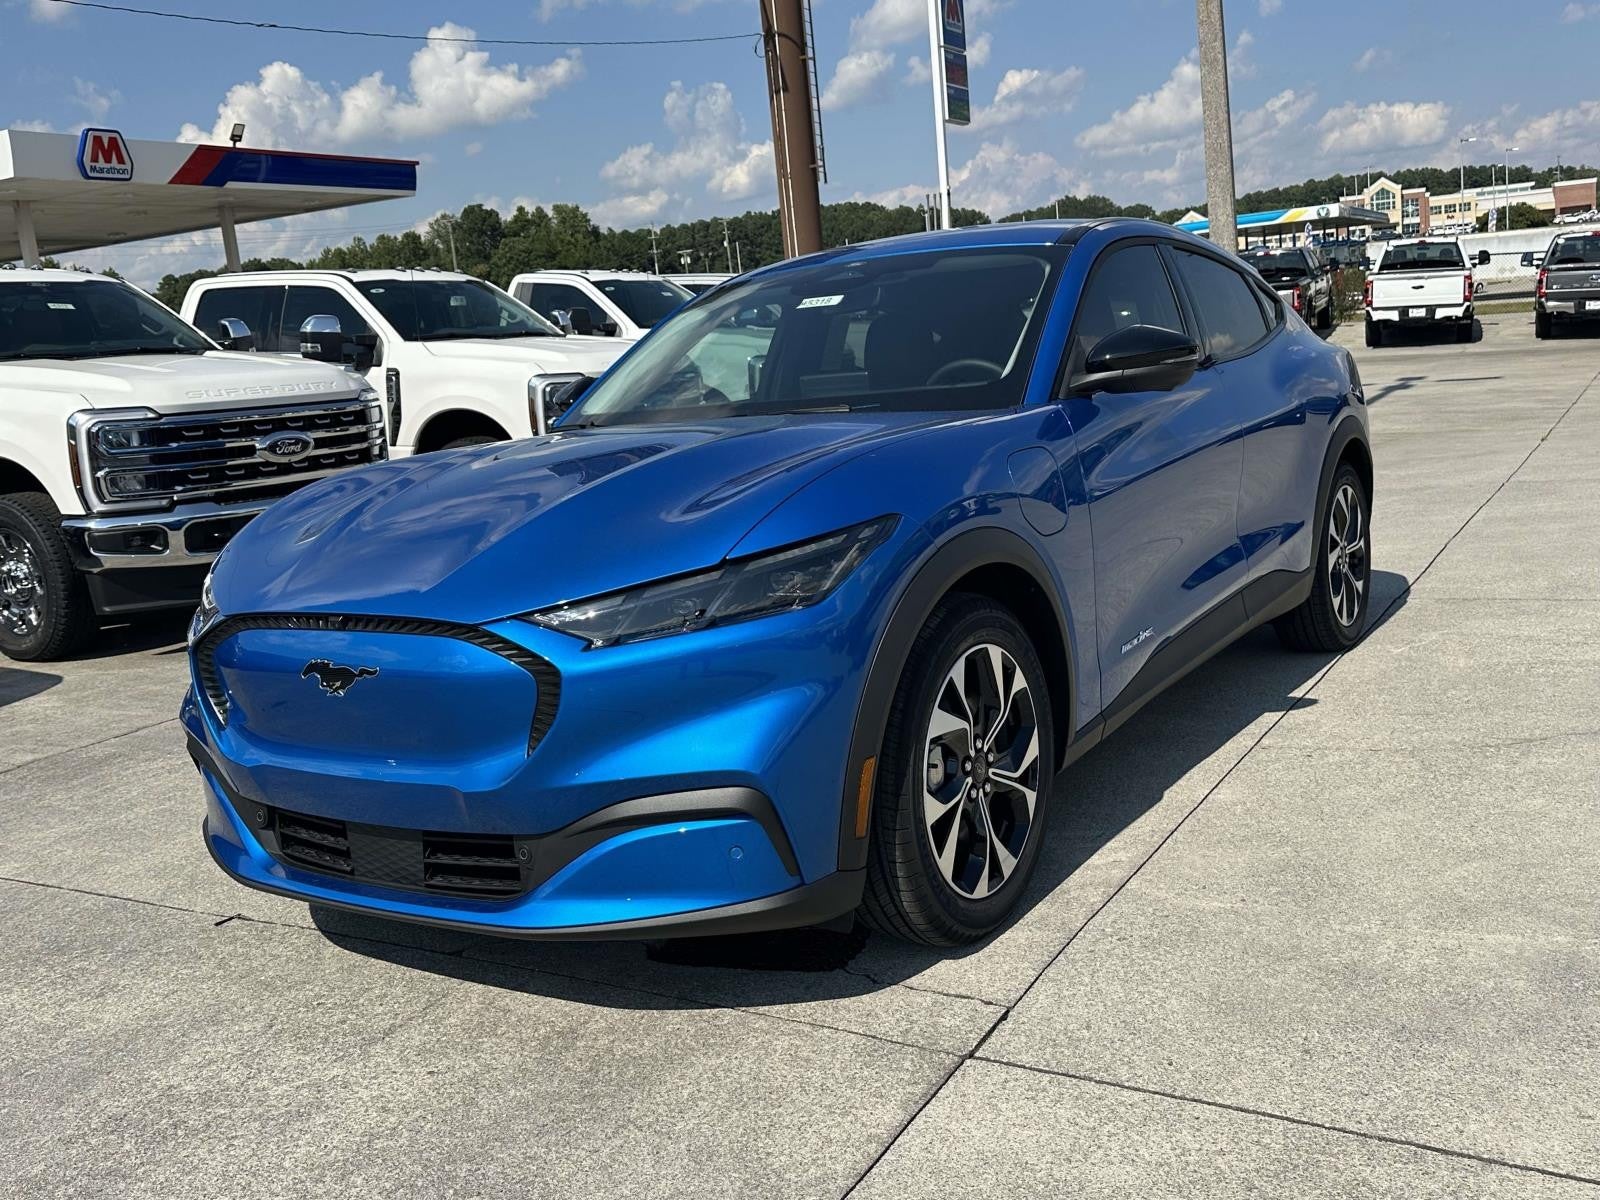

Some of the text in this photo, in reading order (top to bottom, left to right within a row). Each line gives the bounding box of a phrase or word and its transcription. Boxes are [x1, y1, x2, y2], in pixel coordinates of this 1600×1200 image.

[90, 135, 126, 165] M
[90, 165, 129, 175] Marathon
[185, 380, 337, 400] SUPER DUTY
[276, 439, 303, 454] Ford
